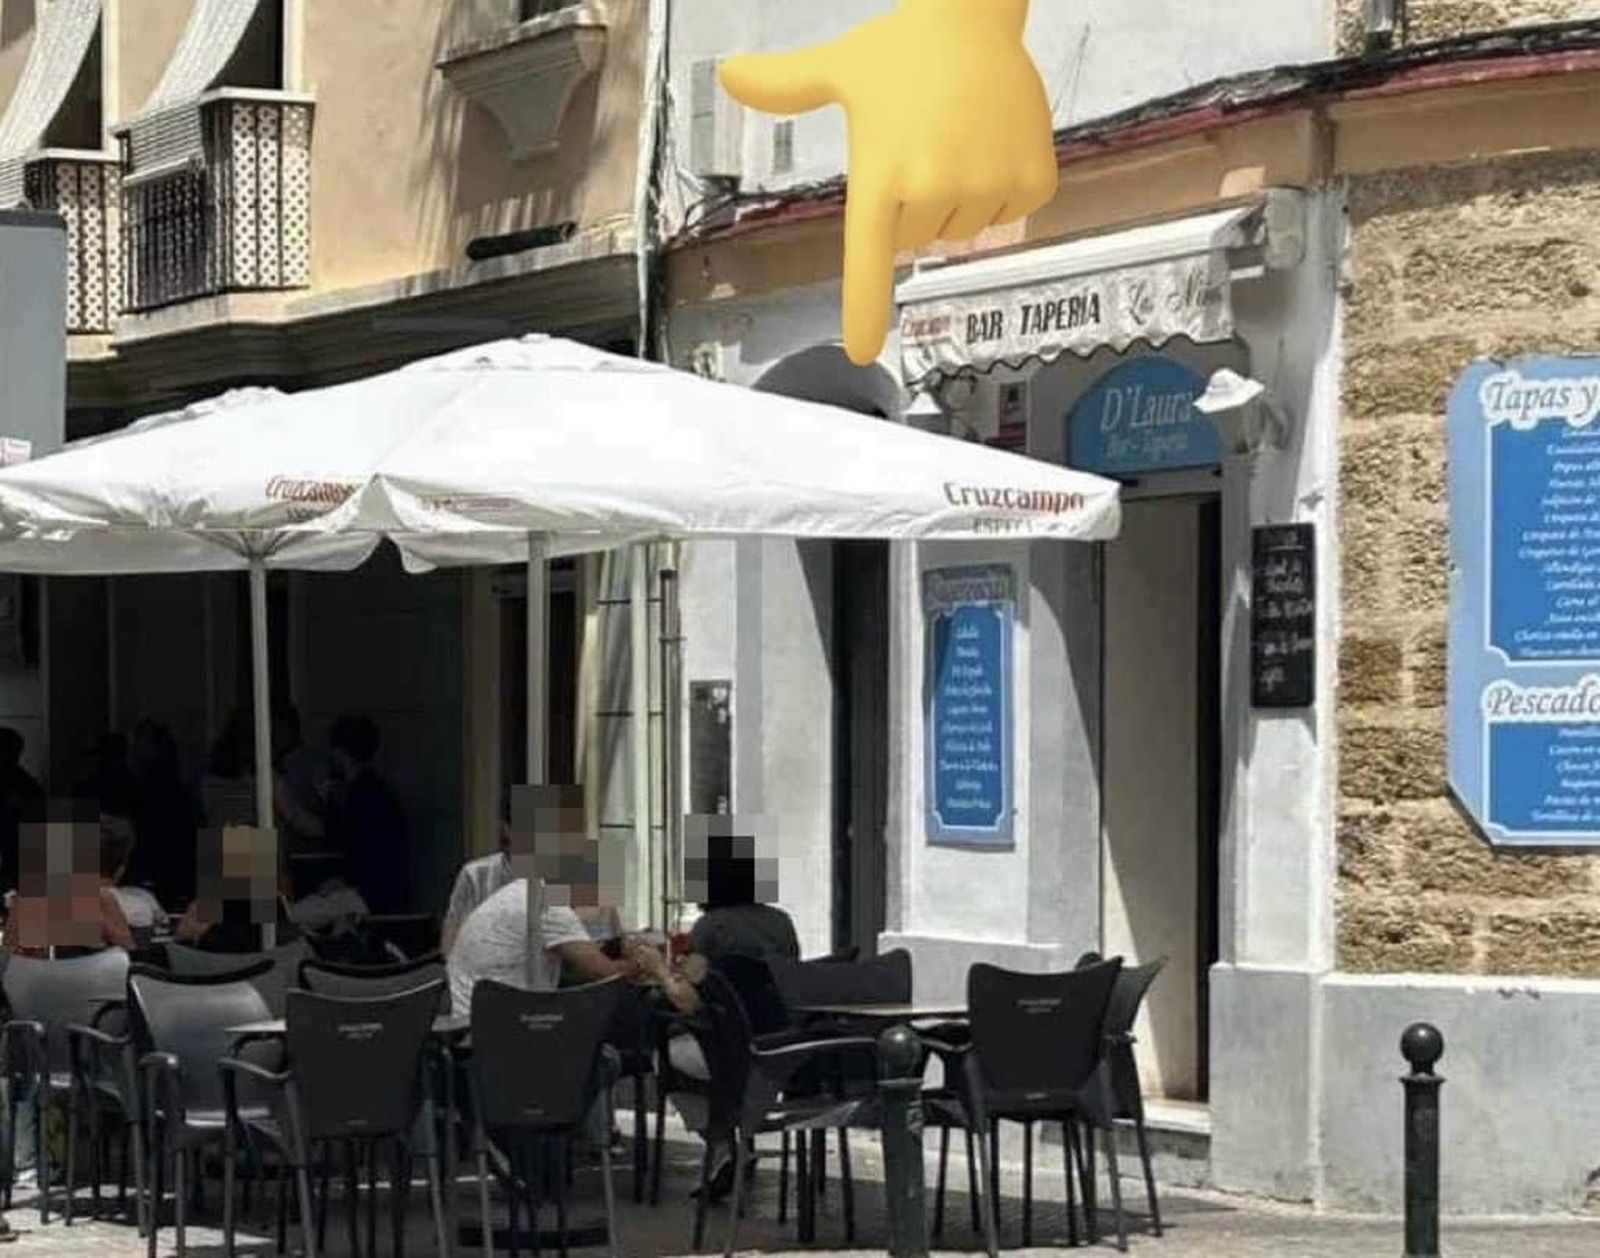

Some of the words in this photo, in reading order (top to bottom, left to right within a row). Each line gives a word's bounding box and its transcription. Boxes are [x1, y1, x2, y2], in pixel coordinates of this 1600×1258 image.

[965, 309, 1004, 345] BAR
[1487, 380, 1573, 420] Tapas
[1573, 383, 1599, 418] y
